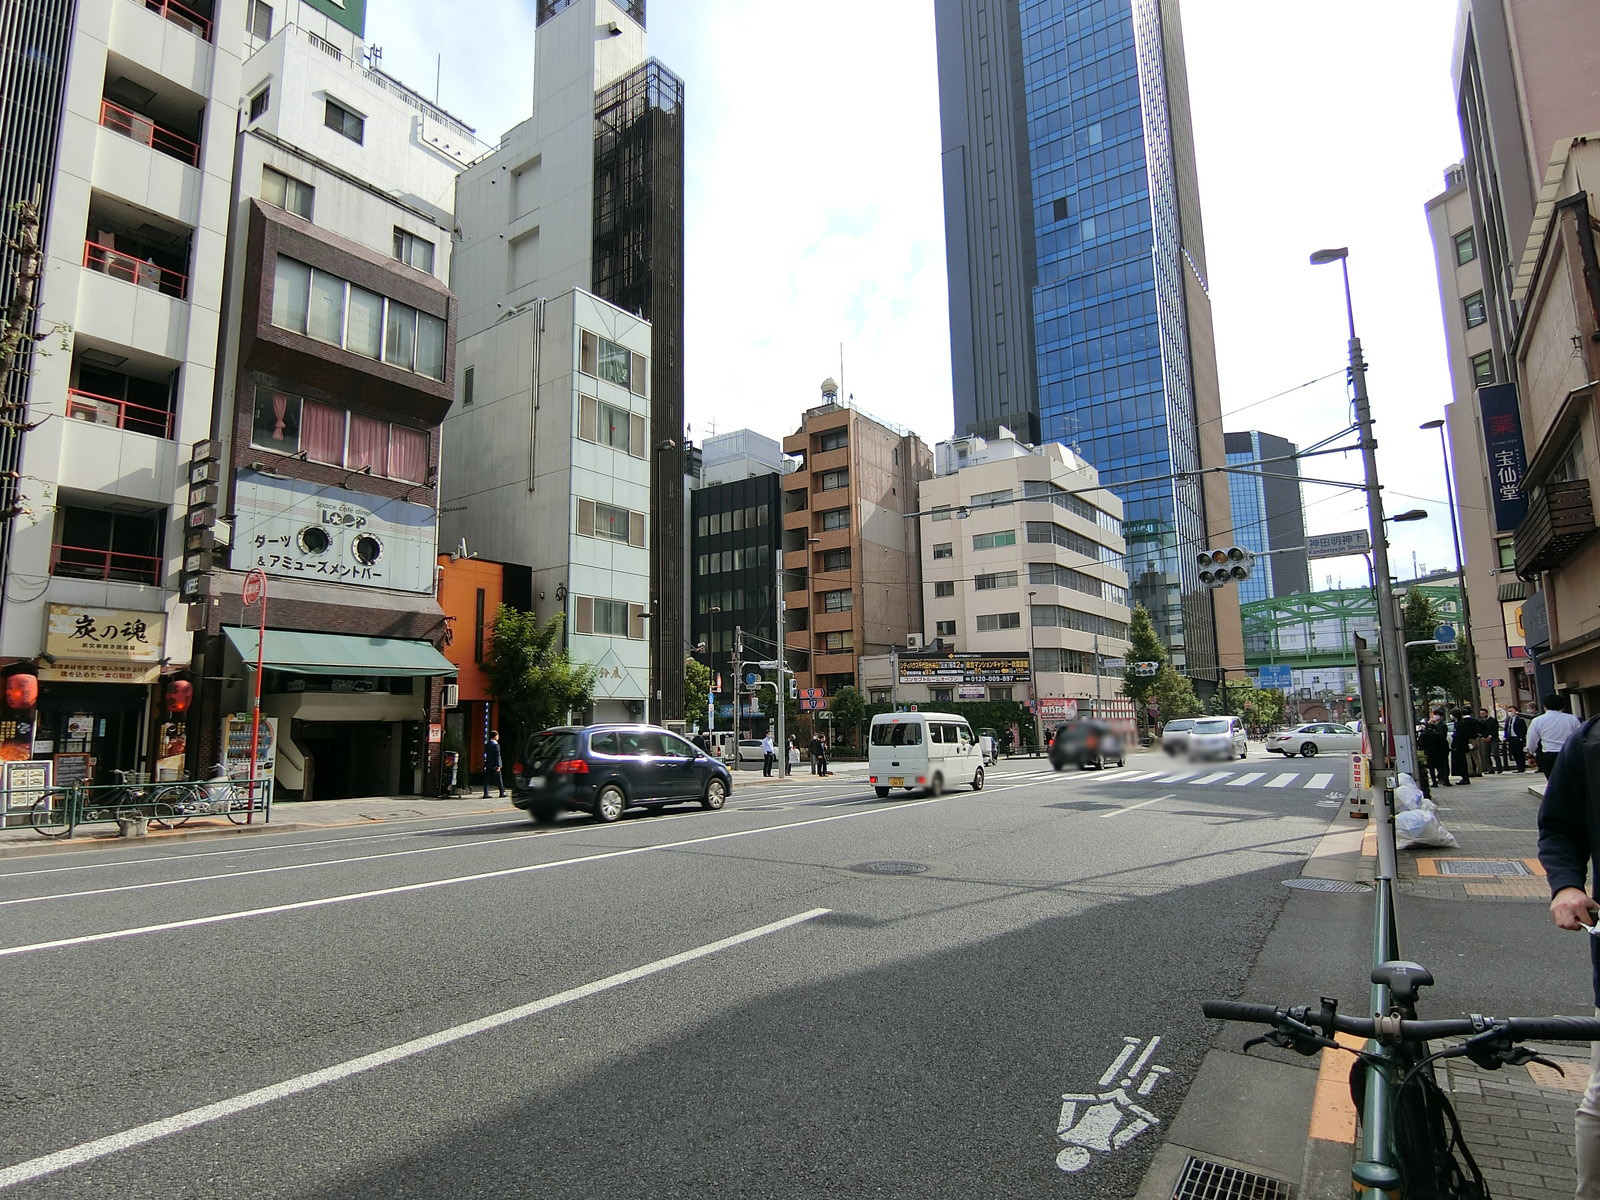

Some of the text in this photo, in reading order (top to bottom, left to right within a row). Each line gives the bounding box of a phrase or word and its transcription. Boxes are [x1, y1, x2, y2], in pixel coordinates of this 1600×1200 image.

[1494, 449, 1520, 501] 宝仙堂
[254, 534, 291, 548] ダーツ
[1309, 533, 1363, 548] 神田明神下
[69, 614, 149, 643] 炭の魂
